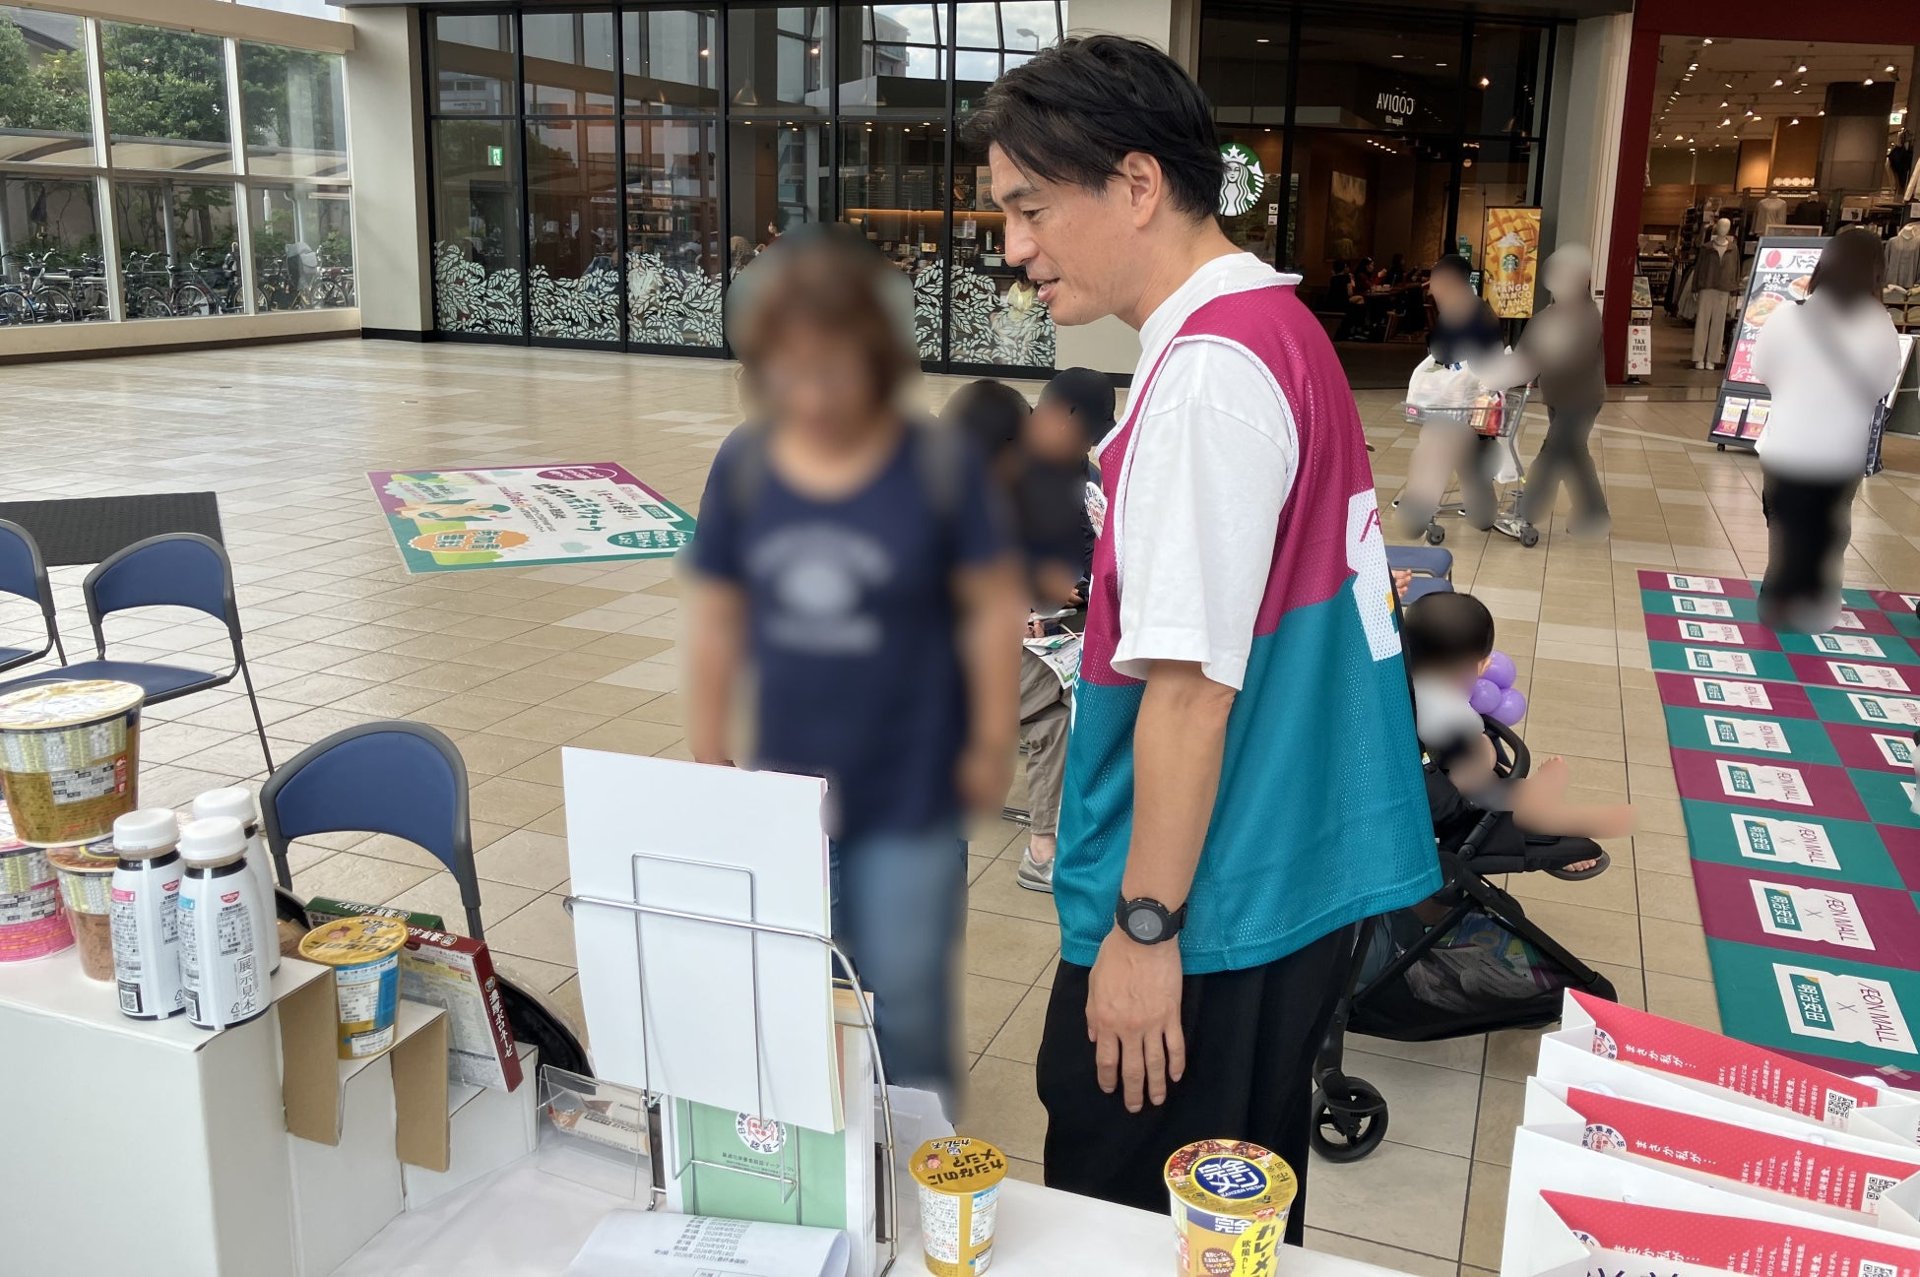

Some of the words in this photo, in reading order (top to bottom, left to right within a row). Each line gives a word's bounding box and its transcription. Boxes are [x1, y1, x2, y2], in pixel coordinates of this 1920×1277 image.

[1786, 254, 1820, 269] バーミ
[1748, 826, 1770, 850] 明治安田
[1769, 894, 1795, 925] 明治安田
[405, 925, 444, 943] 濃厚ボロ
[239, 959, 257, 1012] 展示見本
[1795, 982, 1827, 1022] 明治安田
[1868, 1011, 1900, 1044] MALL
[927, 1159, 1004, 1185] カシなのに
[1198, 1159, 1251, 1181] 完全
[1214, 1217, 1252, 1234] 完全
[1251, 1224, 1276, 1277] カレーメ
